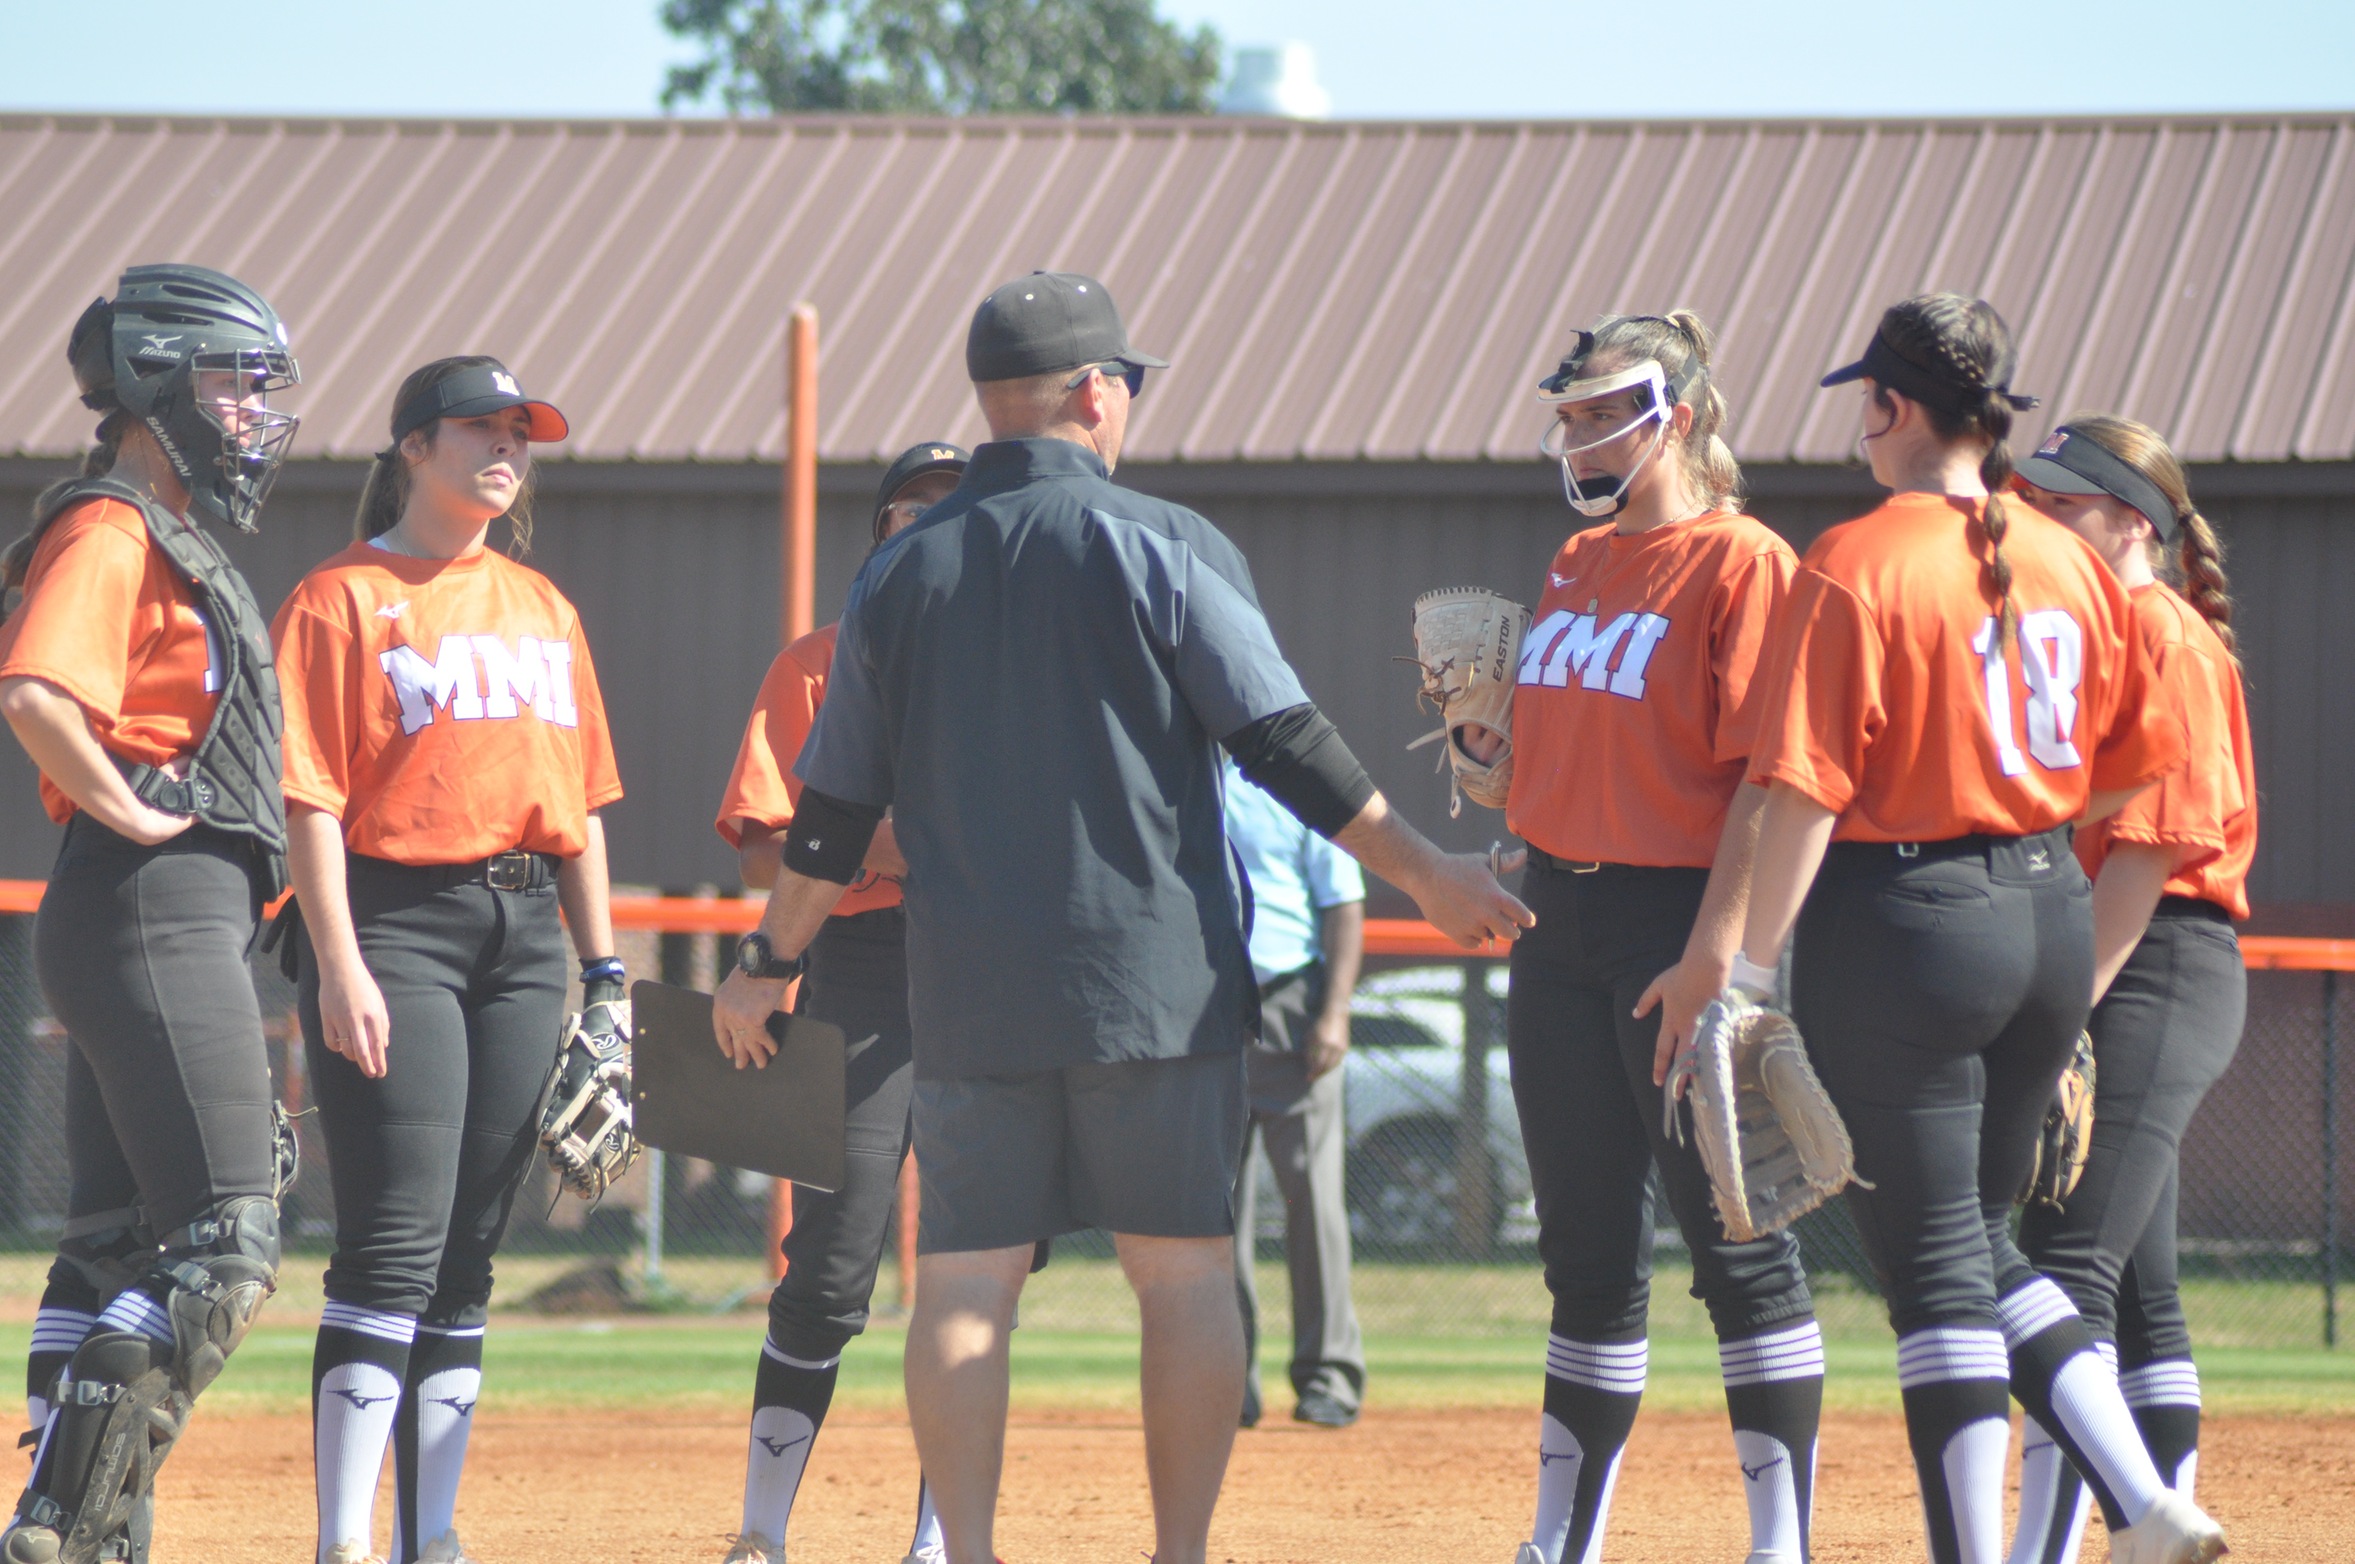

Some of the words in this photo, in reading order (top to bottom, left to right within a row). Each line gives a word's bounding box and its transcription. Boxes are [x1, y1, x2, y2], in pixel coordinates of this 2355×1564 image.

[146, 416, 192, 477] SAMURAI
[379, 634, 577, 737] MMI
[1492, 615, 1511, 683] EASTON
[1972, 609, 2082, 777] 18
[95, 1433, 126, 1512] samurai
